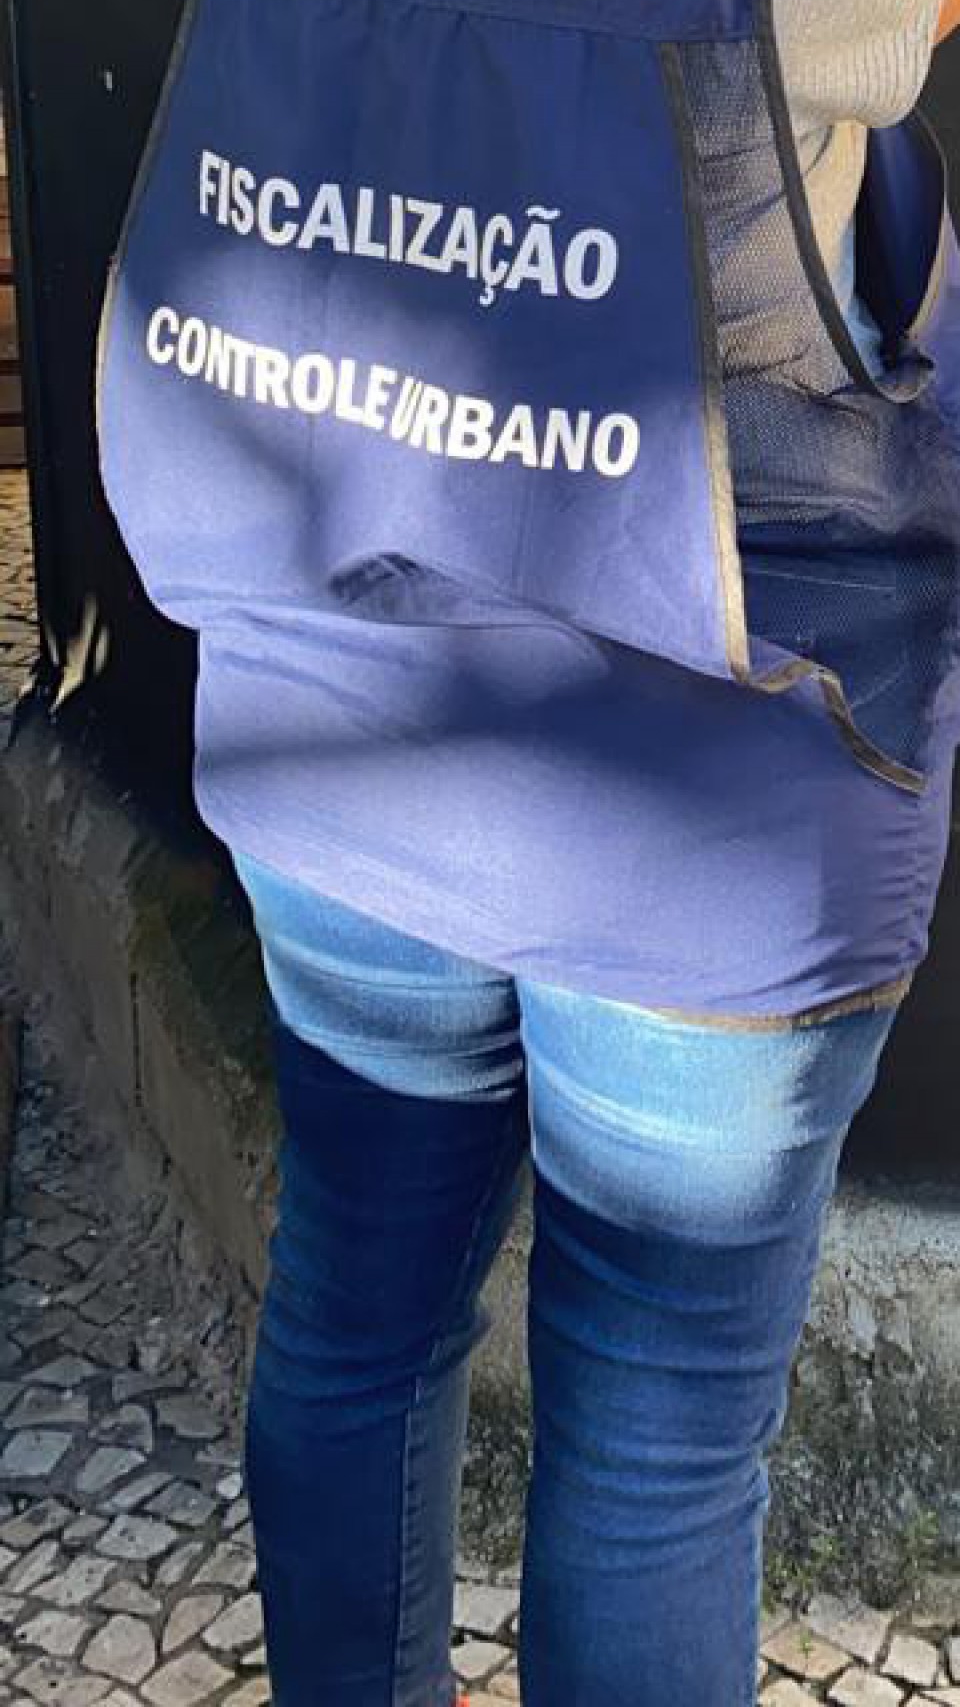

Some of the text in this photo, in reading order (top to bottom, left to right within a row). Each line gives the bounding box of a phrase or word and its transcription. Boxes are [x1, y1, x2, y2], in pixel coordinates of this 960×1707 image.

[199, 149, 619, 306] FISCALIZAÇÃO
[146, 305, 641, 478] CONTROLE URBANO
